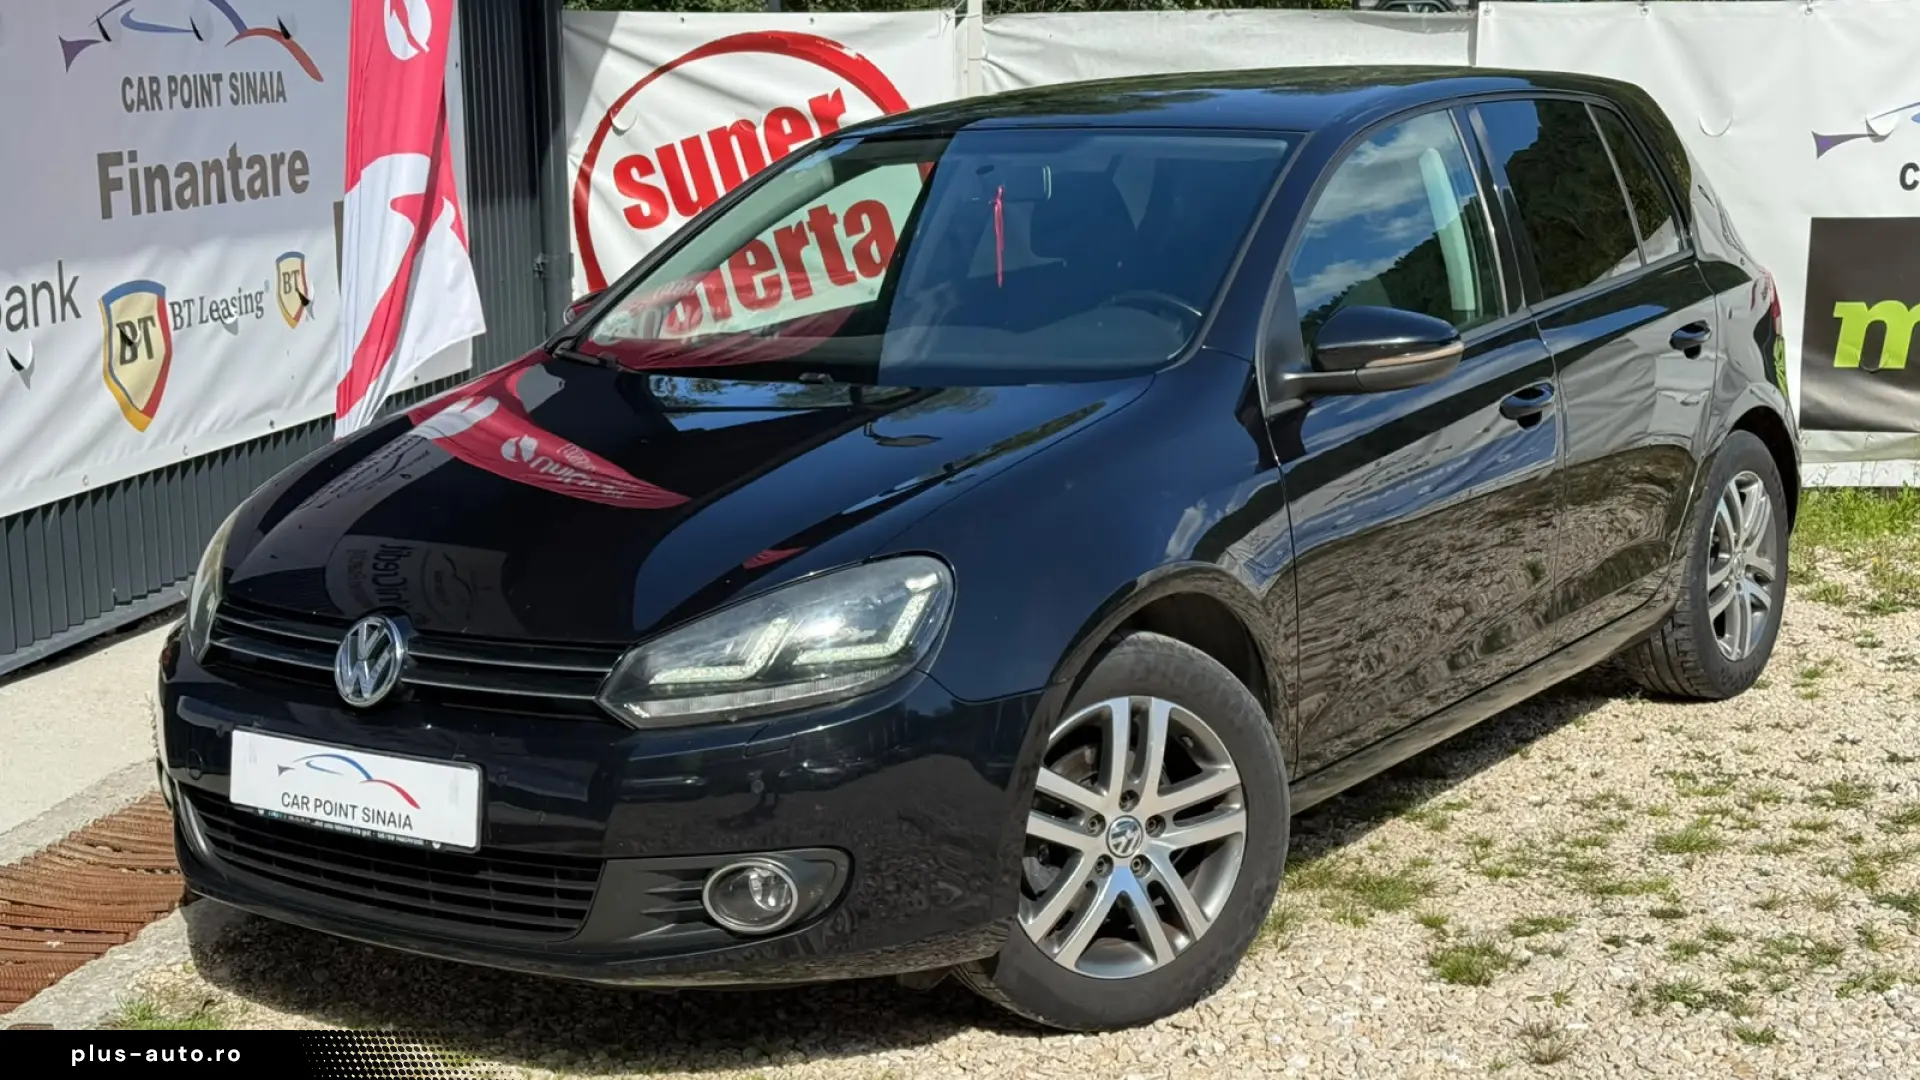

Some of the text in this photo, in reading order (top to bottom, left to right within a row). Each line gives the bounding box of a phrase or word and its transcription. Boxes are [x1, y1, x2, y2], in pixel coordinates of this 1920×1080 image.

[121, 71, 287, 113] CAR POINT SINAIA
[97, 141, 310, 220] Finantare
[0, 260, 82, 332] ank
[282, 269, 300, 294] BT
[168, 286, 264, 331] BT Leasing
[116, 316, 156, 366] BT
[281, 792, 310, 811] CAR
[314, 798, 358, 820] POINT
[362, 807, 413, 831] SINAIA
